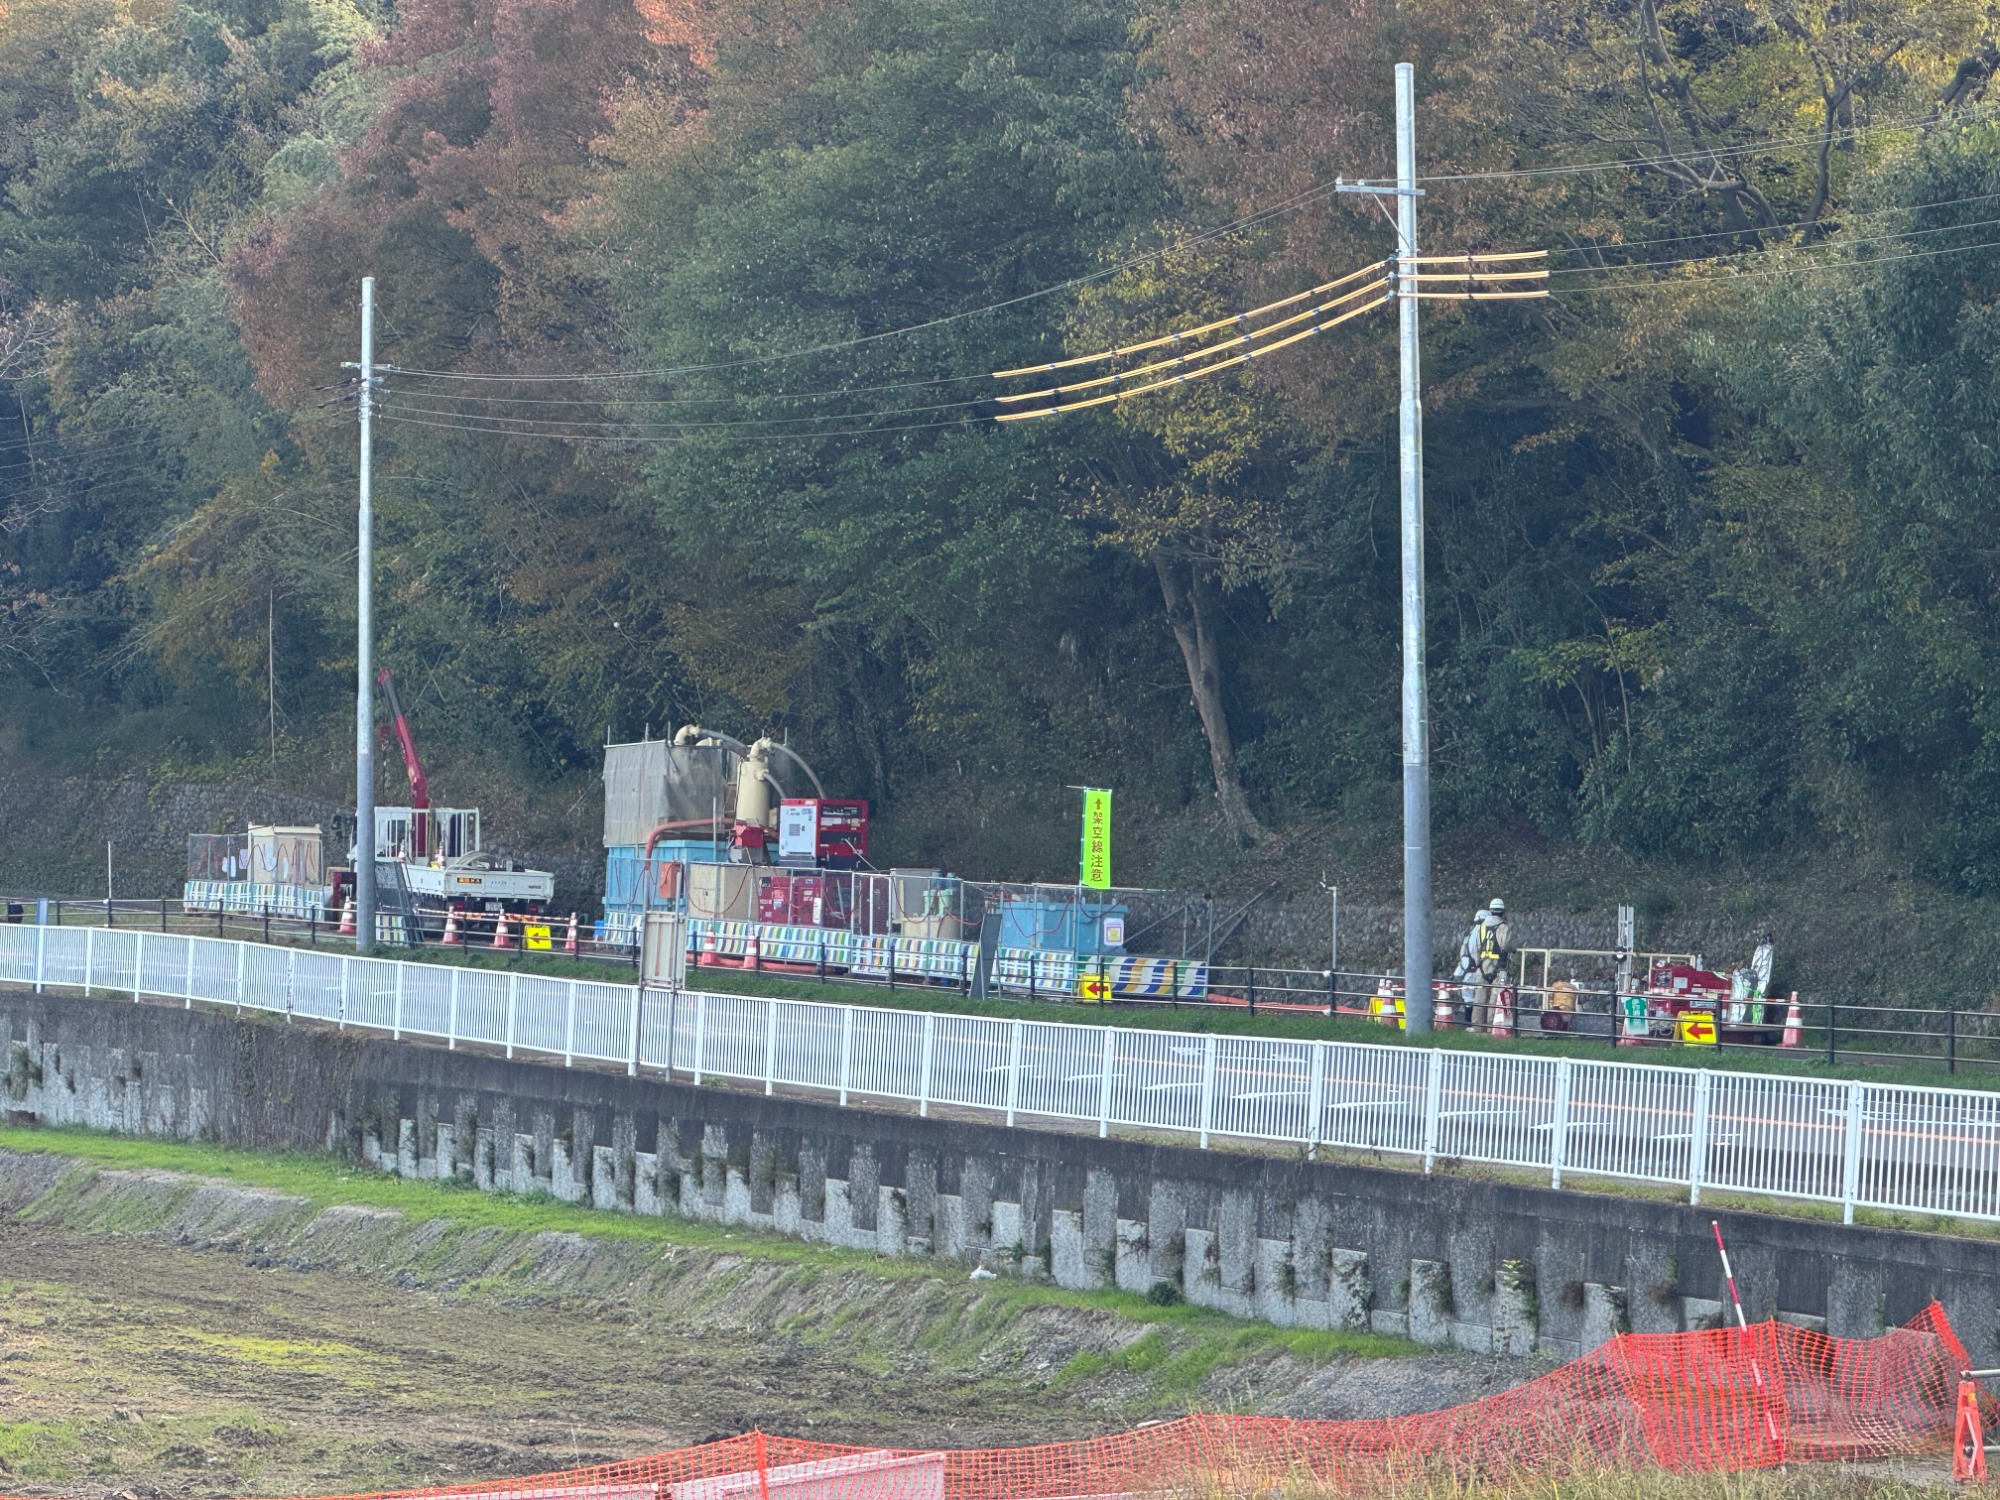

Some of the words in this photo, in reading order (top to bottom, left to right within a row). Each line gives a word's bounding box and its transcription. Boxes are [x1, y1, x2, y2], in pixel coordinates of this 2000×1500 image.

[1090, 811, 1103, 882] 架空線注意
